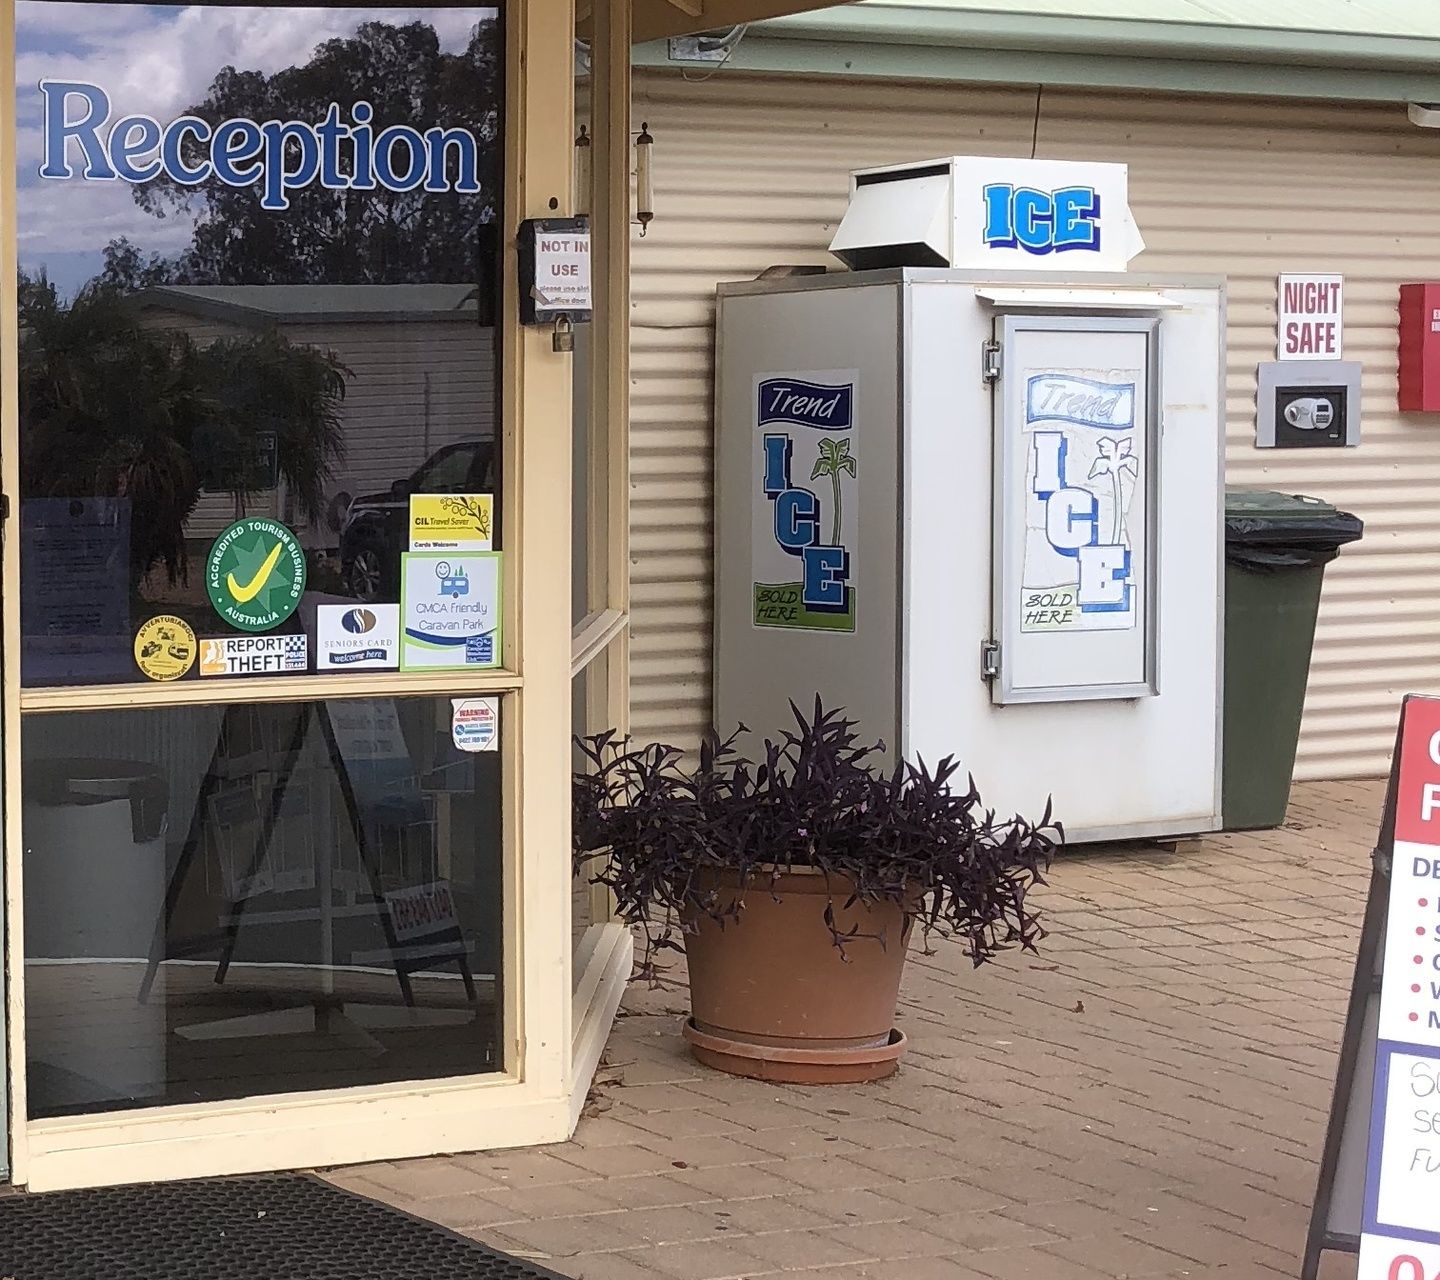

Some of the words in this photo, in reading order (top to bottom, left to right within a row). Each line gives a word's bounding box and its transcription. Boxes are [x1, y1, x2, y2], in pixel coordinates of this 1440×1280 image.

[39, 78, 481, 210] Reception
[983, 182, 1100, 255] ICE
[541, 240, 570, 252] NOT
[574, 241, 589, 253] IN
[551, 264, 579, 276] USE
[1284, 282, 1340, 314] NIGHT
[1286, 322, 1336, 354] SAFE
[769, 387, 841, 419] Trend
[1040, 383, 1122, 419] Trend
[763, 433, 850, 614] ICE
[1033, 431, 1131, 613] ICE
[211, 526, 244, 588] ACCREDITED
[247, 522, 291, 544] TOURISM
[287, 542, 303, 598] BUSINESS
[757, 588, 799, 605] SOLD
[1025, 592, 1073, 608] SOLD
[225, 606, 280, 625] AUSTRALIA
[416, 602, 449, 614] CMCA
[450, 601, 488, 615] Friendly
[757, 605, 798, 622] HERE
[419, 619, 460, 631] Caravan
[462, 618, 484, 630] Park
[1025, 609, 1073, 625] HERE
[227, 637, 285, 653] REPORT
[324, 639, 364, 648] SENIORS
[367, 638, 393, 647] CARD
[227, 654, 285, 672] THEFT
[334, 651, 365, 662] welcome
[365, 650, 382, 658] here
